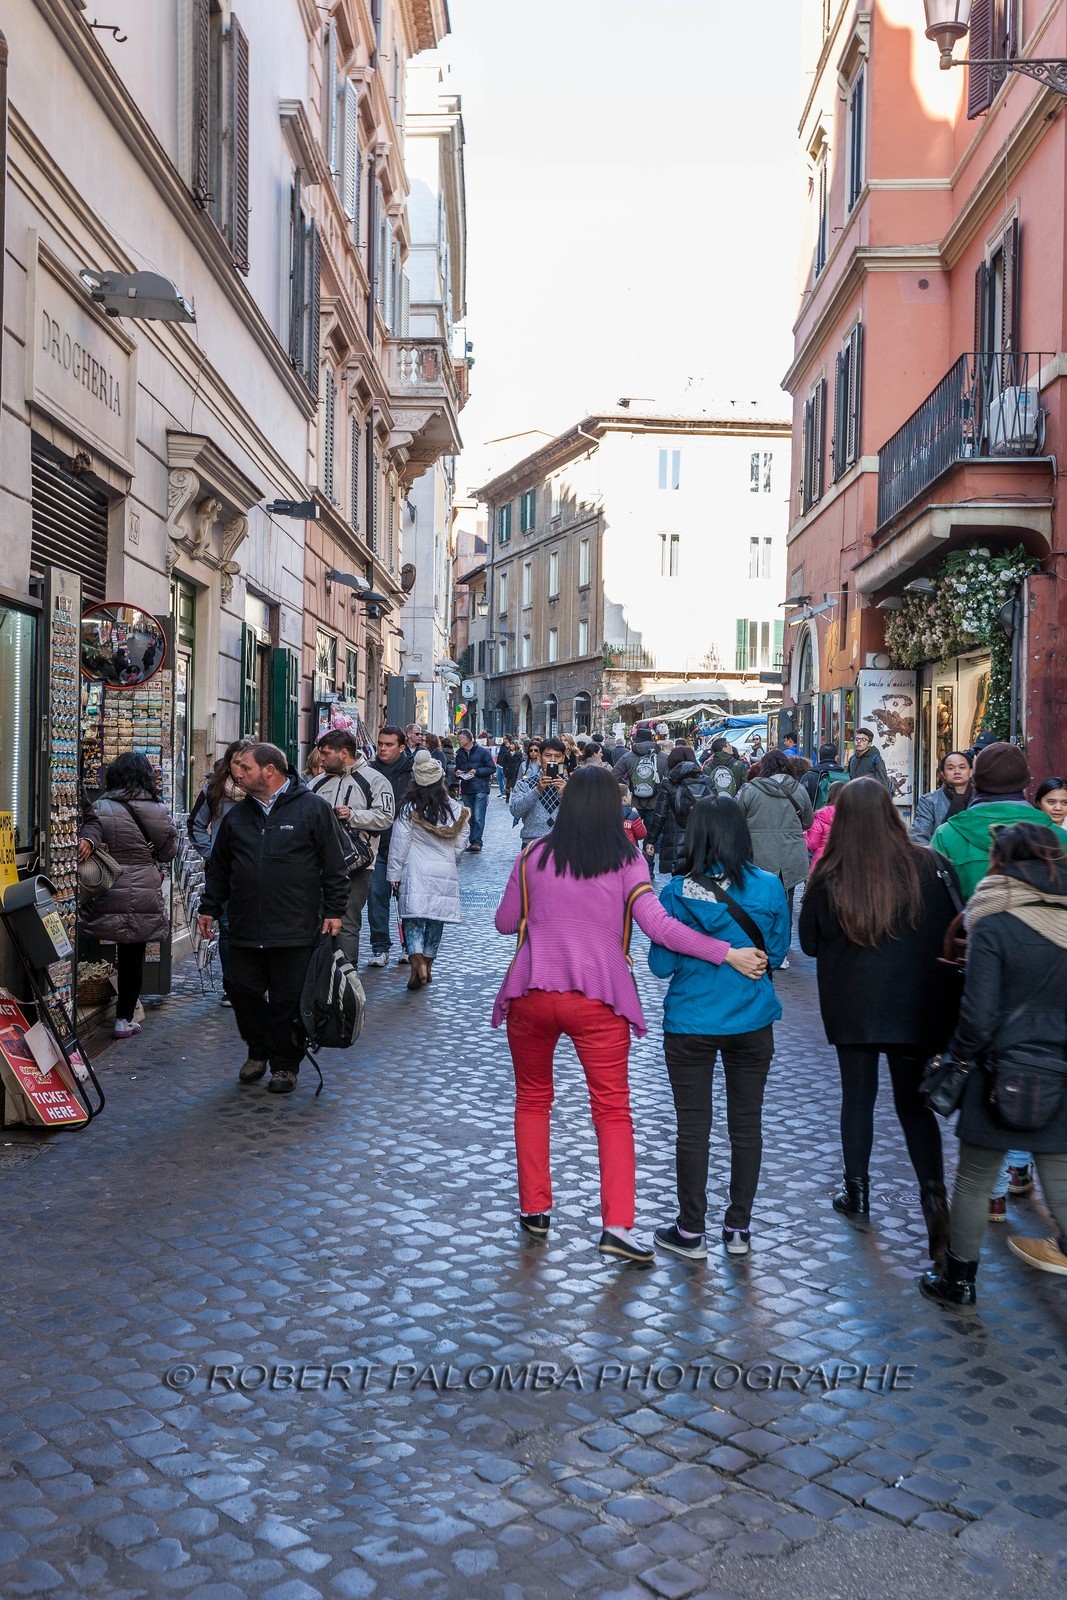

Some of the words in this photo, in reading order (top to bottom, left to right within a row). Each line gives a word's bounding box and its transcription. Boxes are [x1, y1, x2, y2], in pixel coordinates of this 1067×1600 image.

[42, 309, 122, 417] DROGHERIA
[31, 1090, 71, 1105] TICKET
[45, 1105, 77, 1120] HERE
